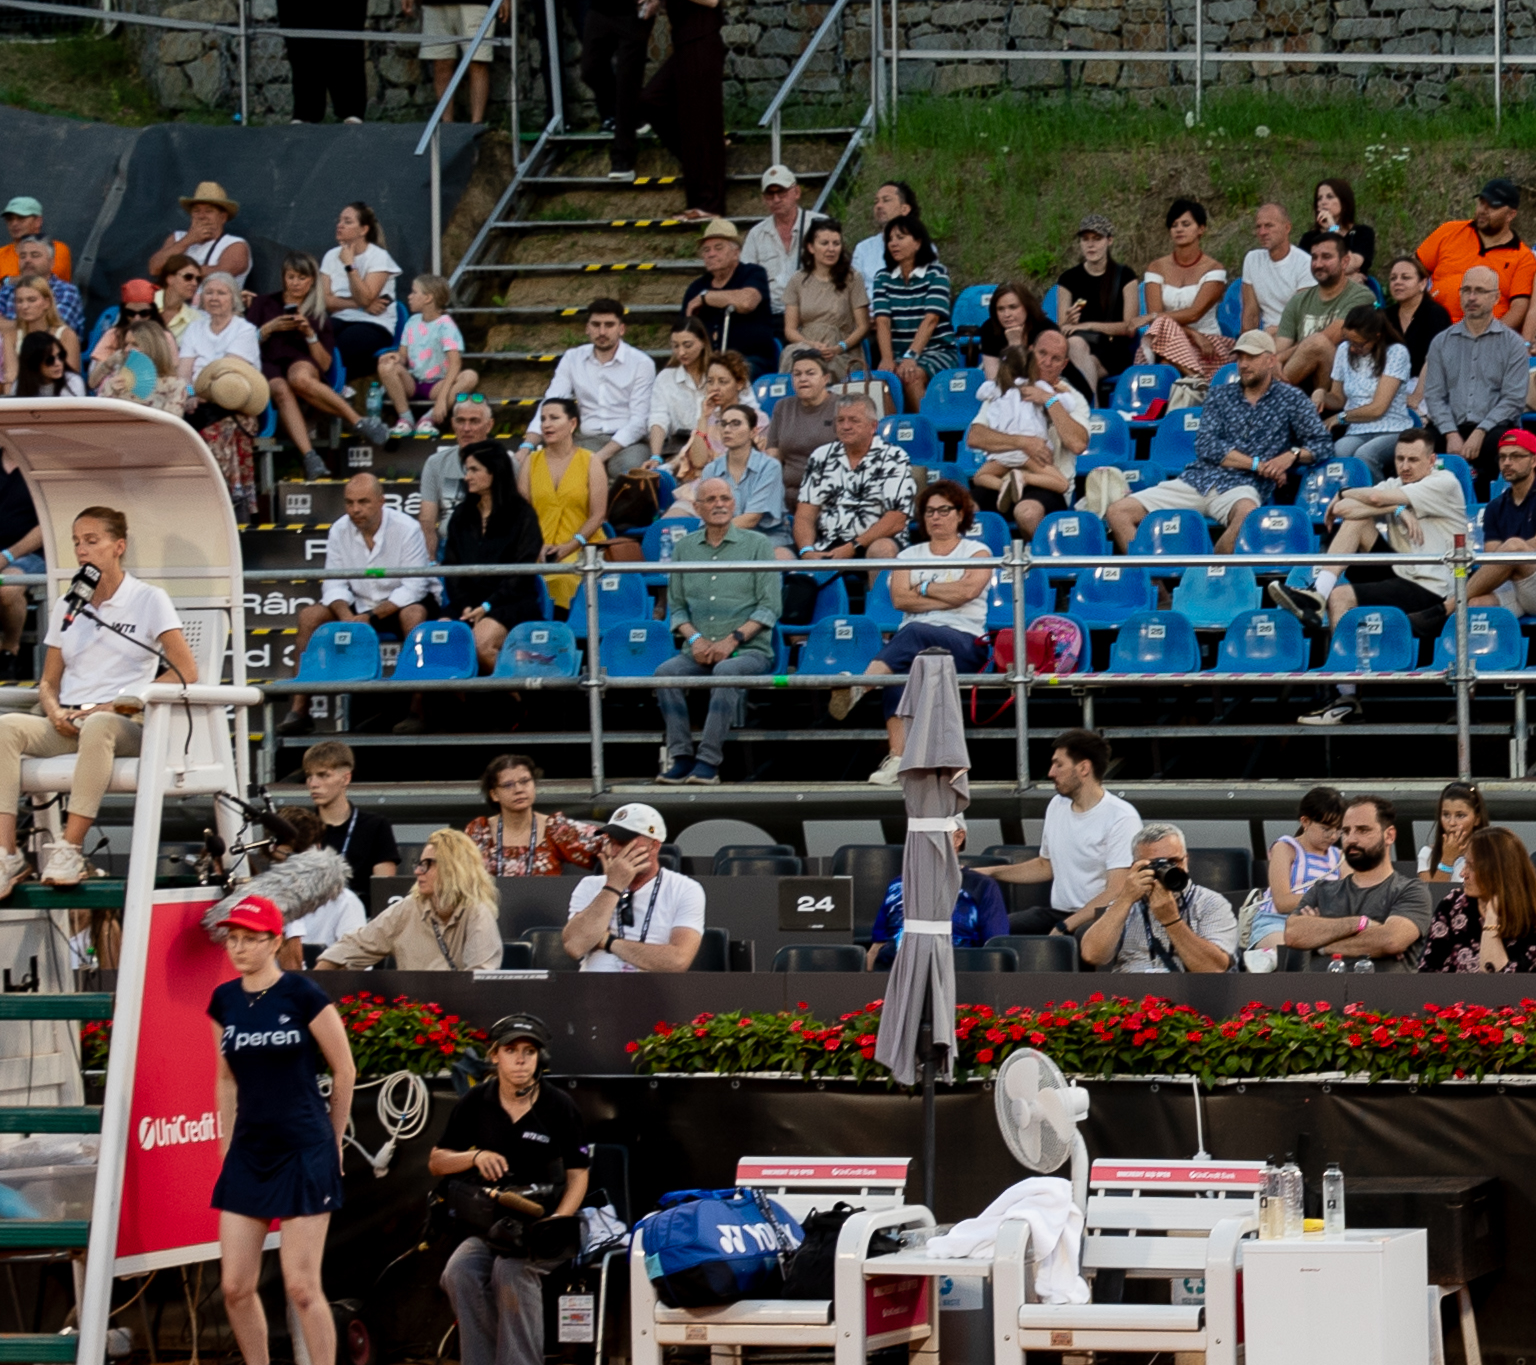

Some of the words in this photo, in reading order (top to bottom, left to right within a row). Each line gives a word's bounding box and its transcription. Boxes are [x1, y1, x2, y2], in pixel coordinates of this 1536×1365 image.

[796, 895, 835, 912] 24
[235, 1029, 301, 1051] peren
[155, 1112, 215, 1147] UniCredit
